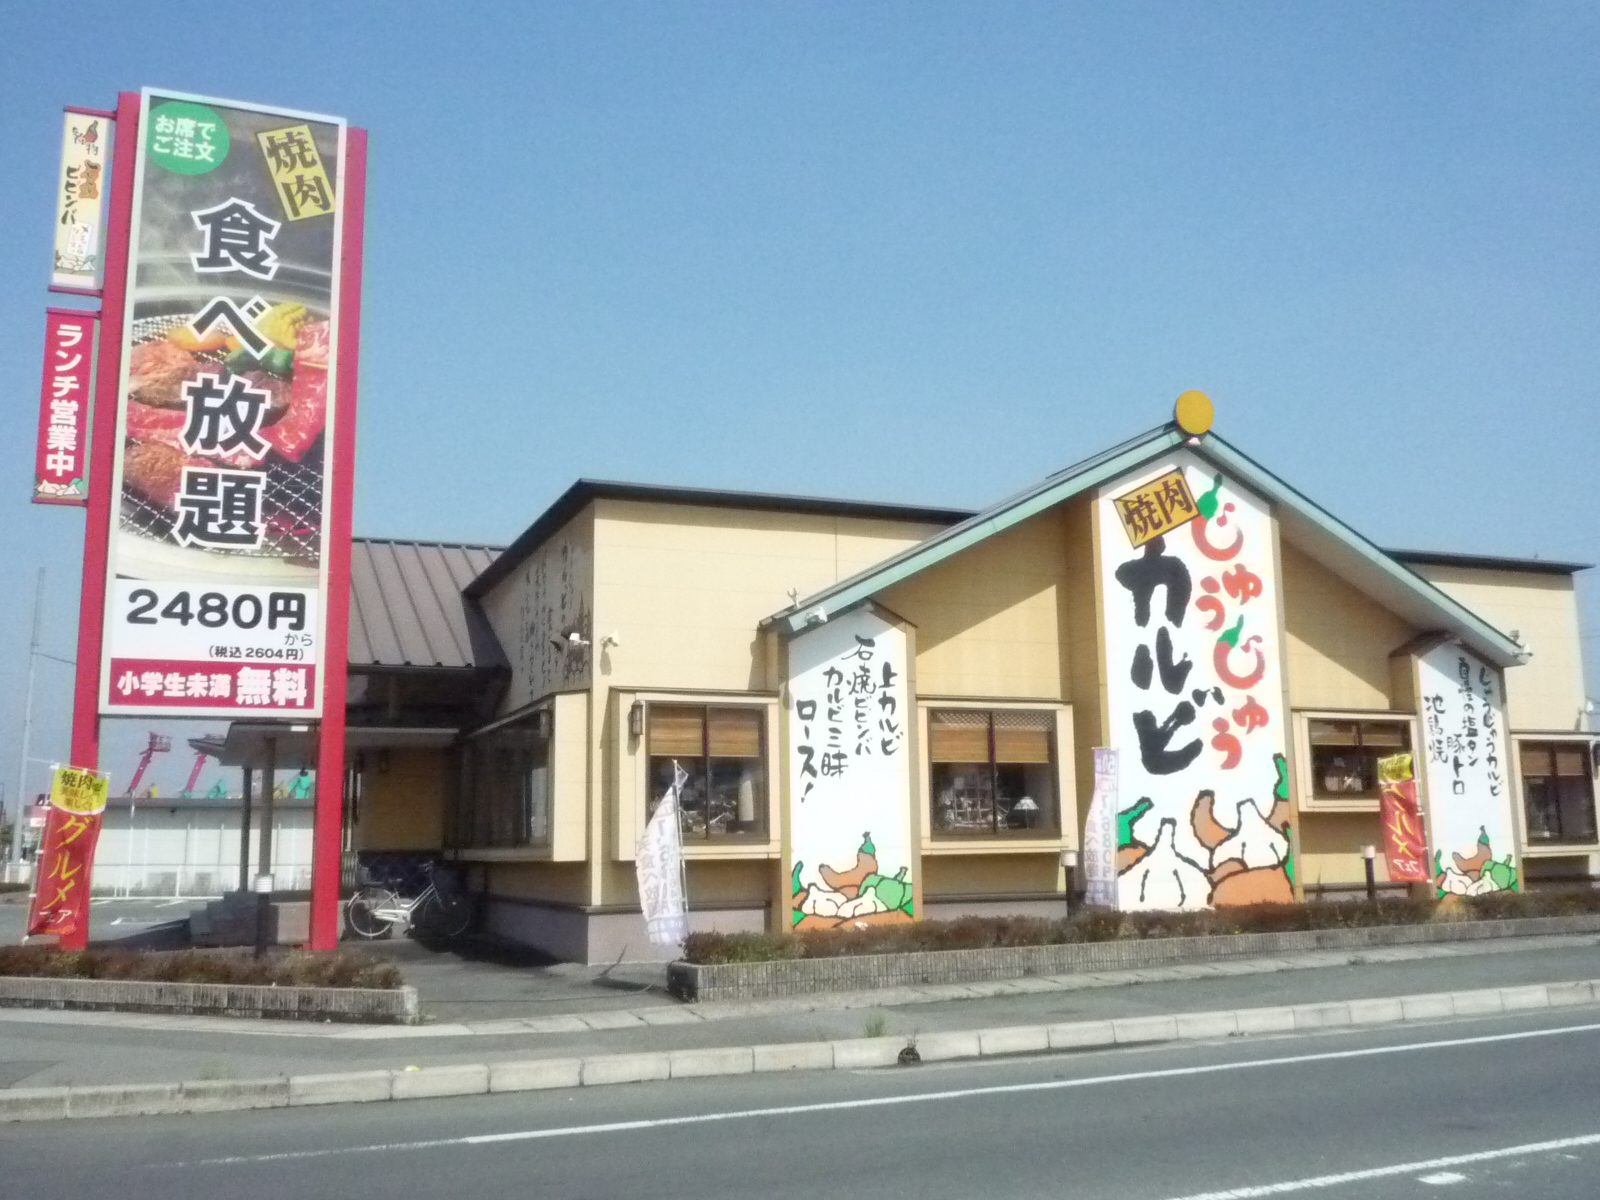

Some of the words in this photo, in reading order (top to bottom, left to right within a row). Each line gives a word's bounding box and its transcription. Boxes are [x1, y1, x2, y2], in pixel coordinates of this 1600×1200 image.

[153, 136, 216, 162] ご注文
[155, 114, 216, 141] お席で
[61, 164, 82, 225] ビビンバ
[265, 130, 332, 218] 焼肉
[46, 324, 83, 477] ランチ営業中
[172, 197, 282, 549] 食べ放題
[1123, 478, 1194, 541] 焼肉
[126, 588, 306, 631] 2480円
[284, 633, 313, 647] から
[1114, 534, 1225, 775] カルビ
[1190, 473, 1270, 770] じゅうじゅう
[117, 671, 231, 698] 小学生未満
[235, 666, 307, 706] 無料
[841, 634, 876, 756] 石焼ビビンバ
[877, 661, 904, 756] 上カルビ
[1479, 666, 1504, 797] じゅうじゅうカルビ
[796, 699, 818, 803] ロース!
[1447, 733, 1465, 795] 豚トロ
[42, 815, 94, 910] グルメ
